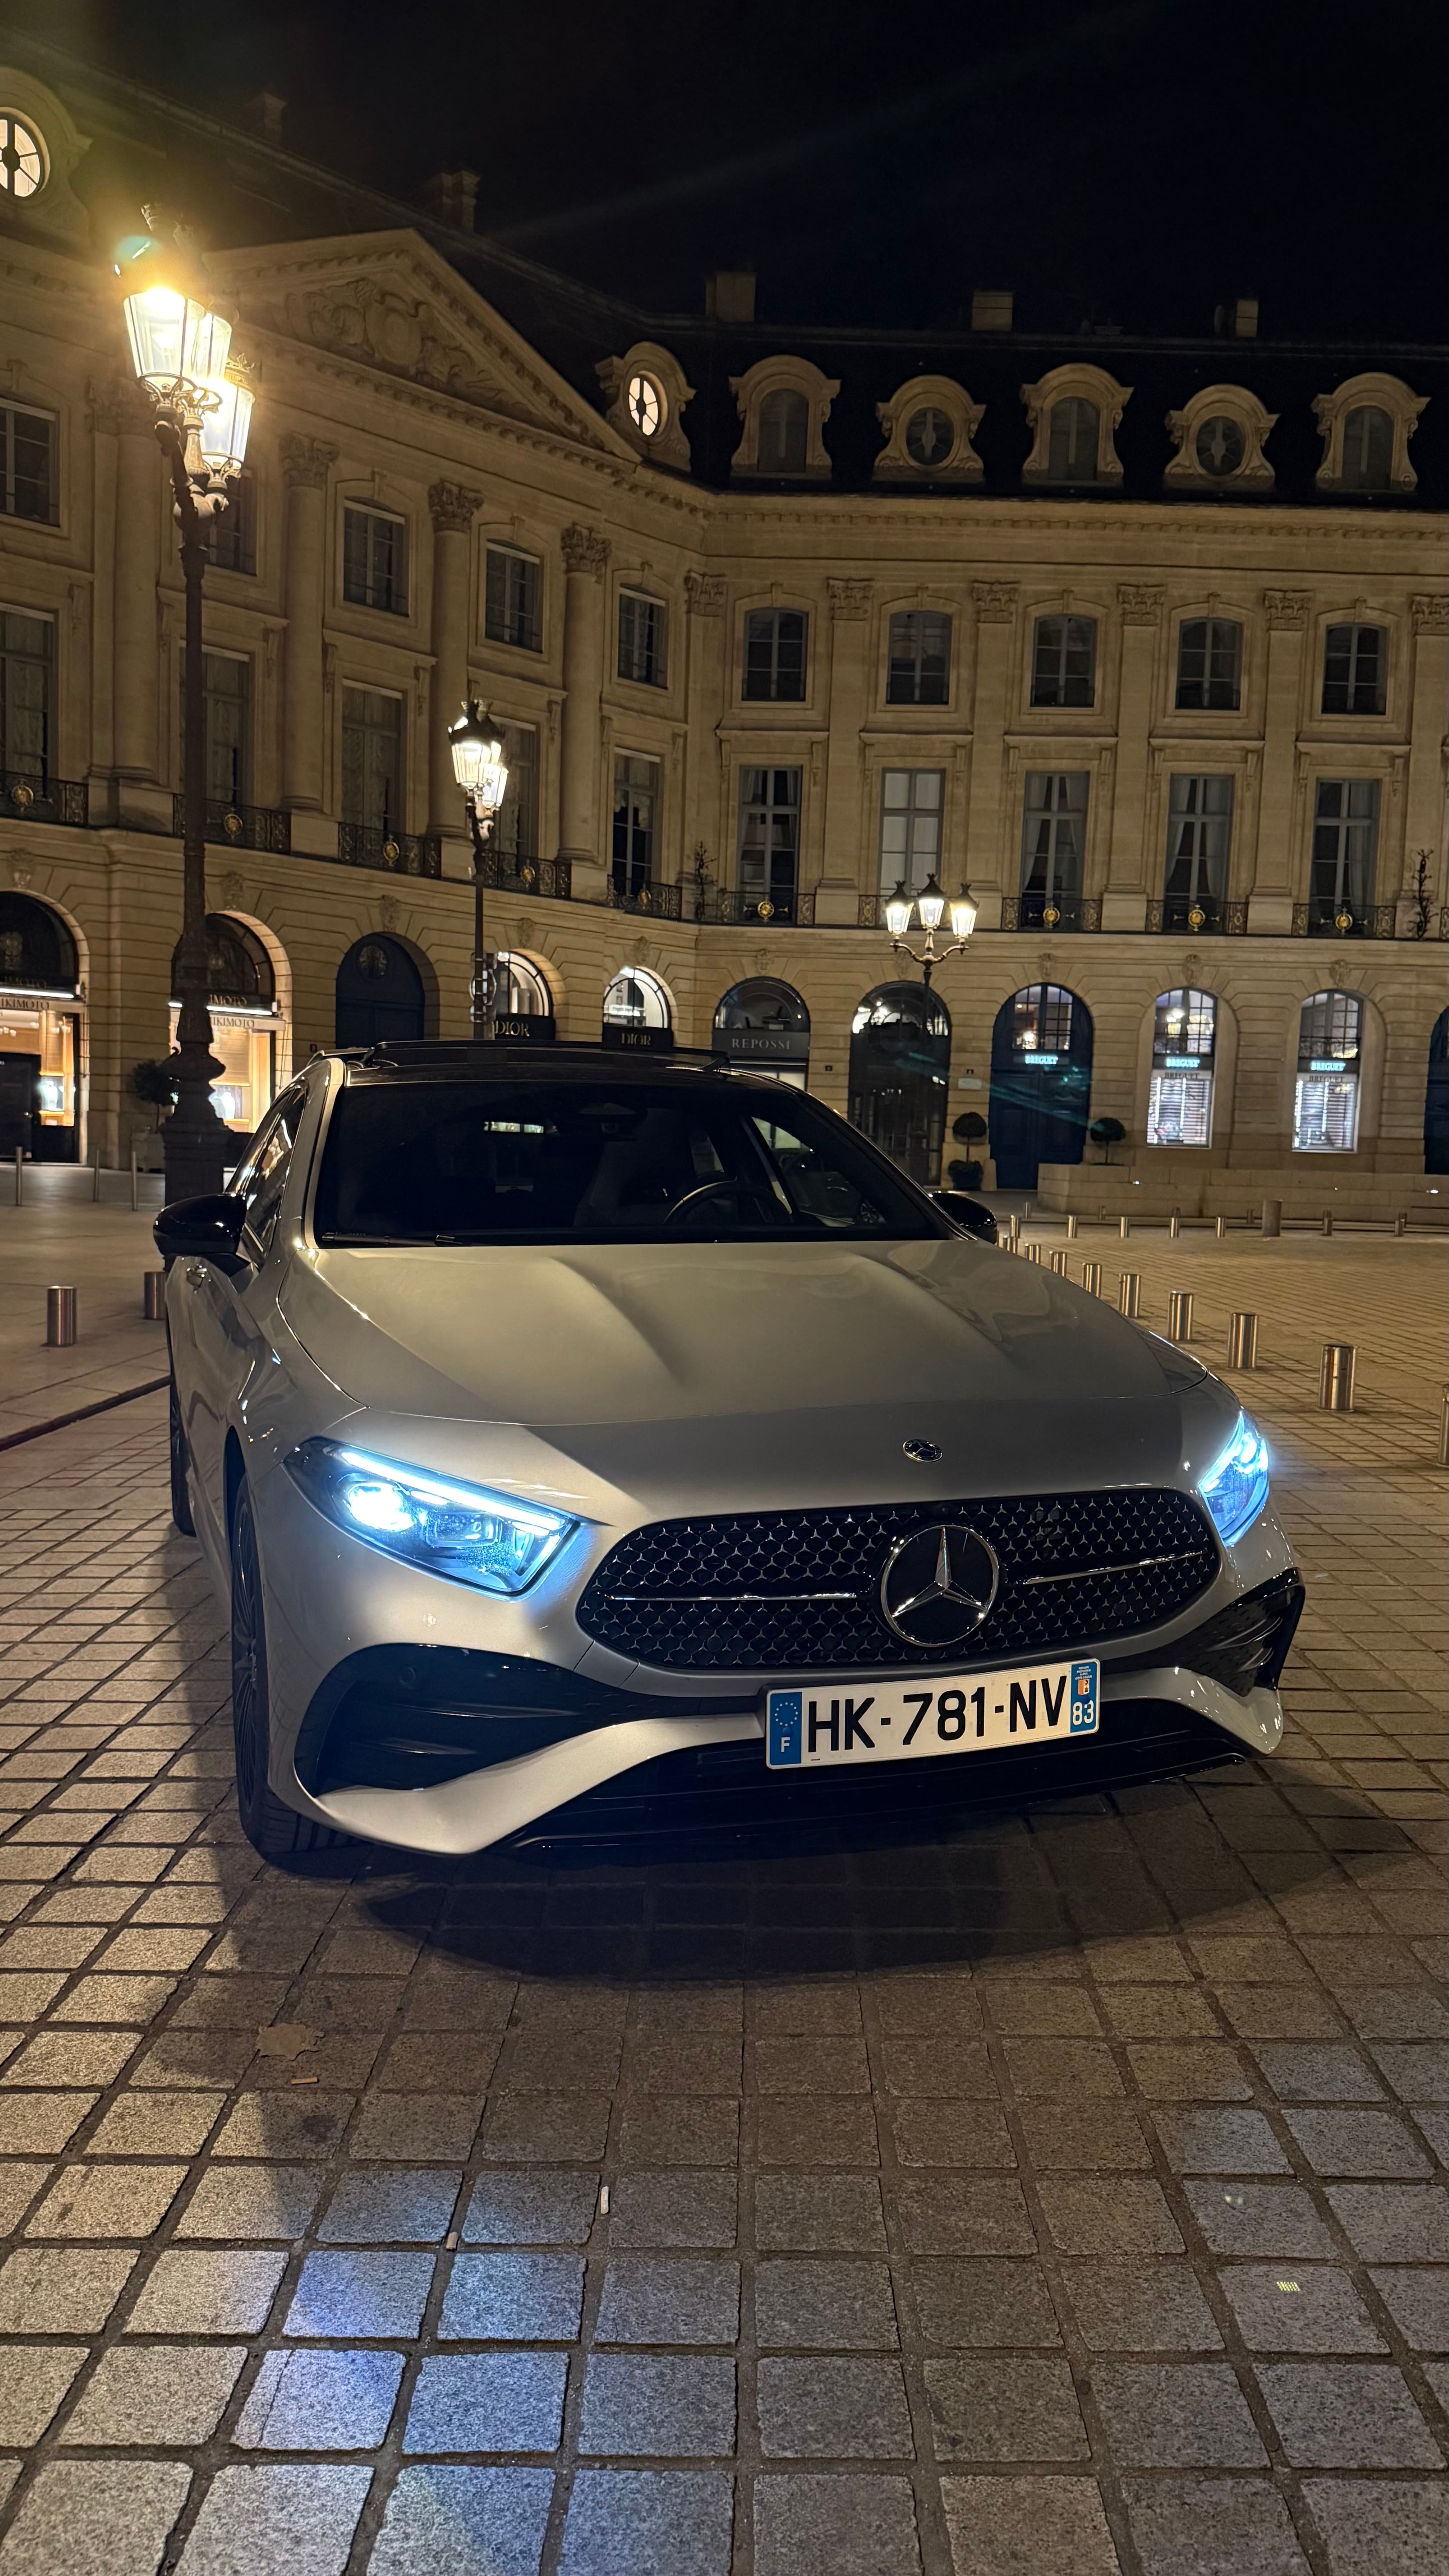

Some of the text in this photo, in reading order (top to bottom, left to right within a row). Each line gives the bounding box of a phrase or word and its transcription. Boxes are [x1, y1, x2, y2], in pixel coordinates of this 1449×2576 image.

[1, 998, 50, 1010] IKIMOTO
[209, 994, 247, 1007] IMOTO
[213, 1017, 255, 1028] IKIMOTO
[495, 1021, 530, 1037] DIOR
[621, 1033, 651, 1045] DIOR
[732, 1038, 790, 1049] REPOSSI
[781, 1675, 1094, 1753] F HK-781-NV 83
